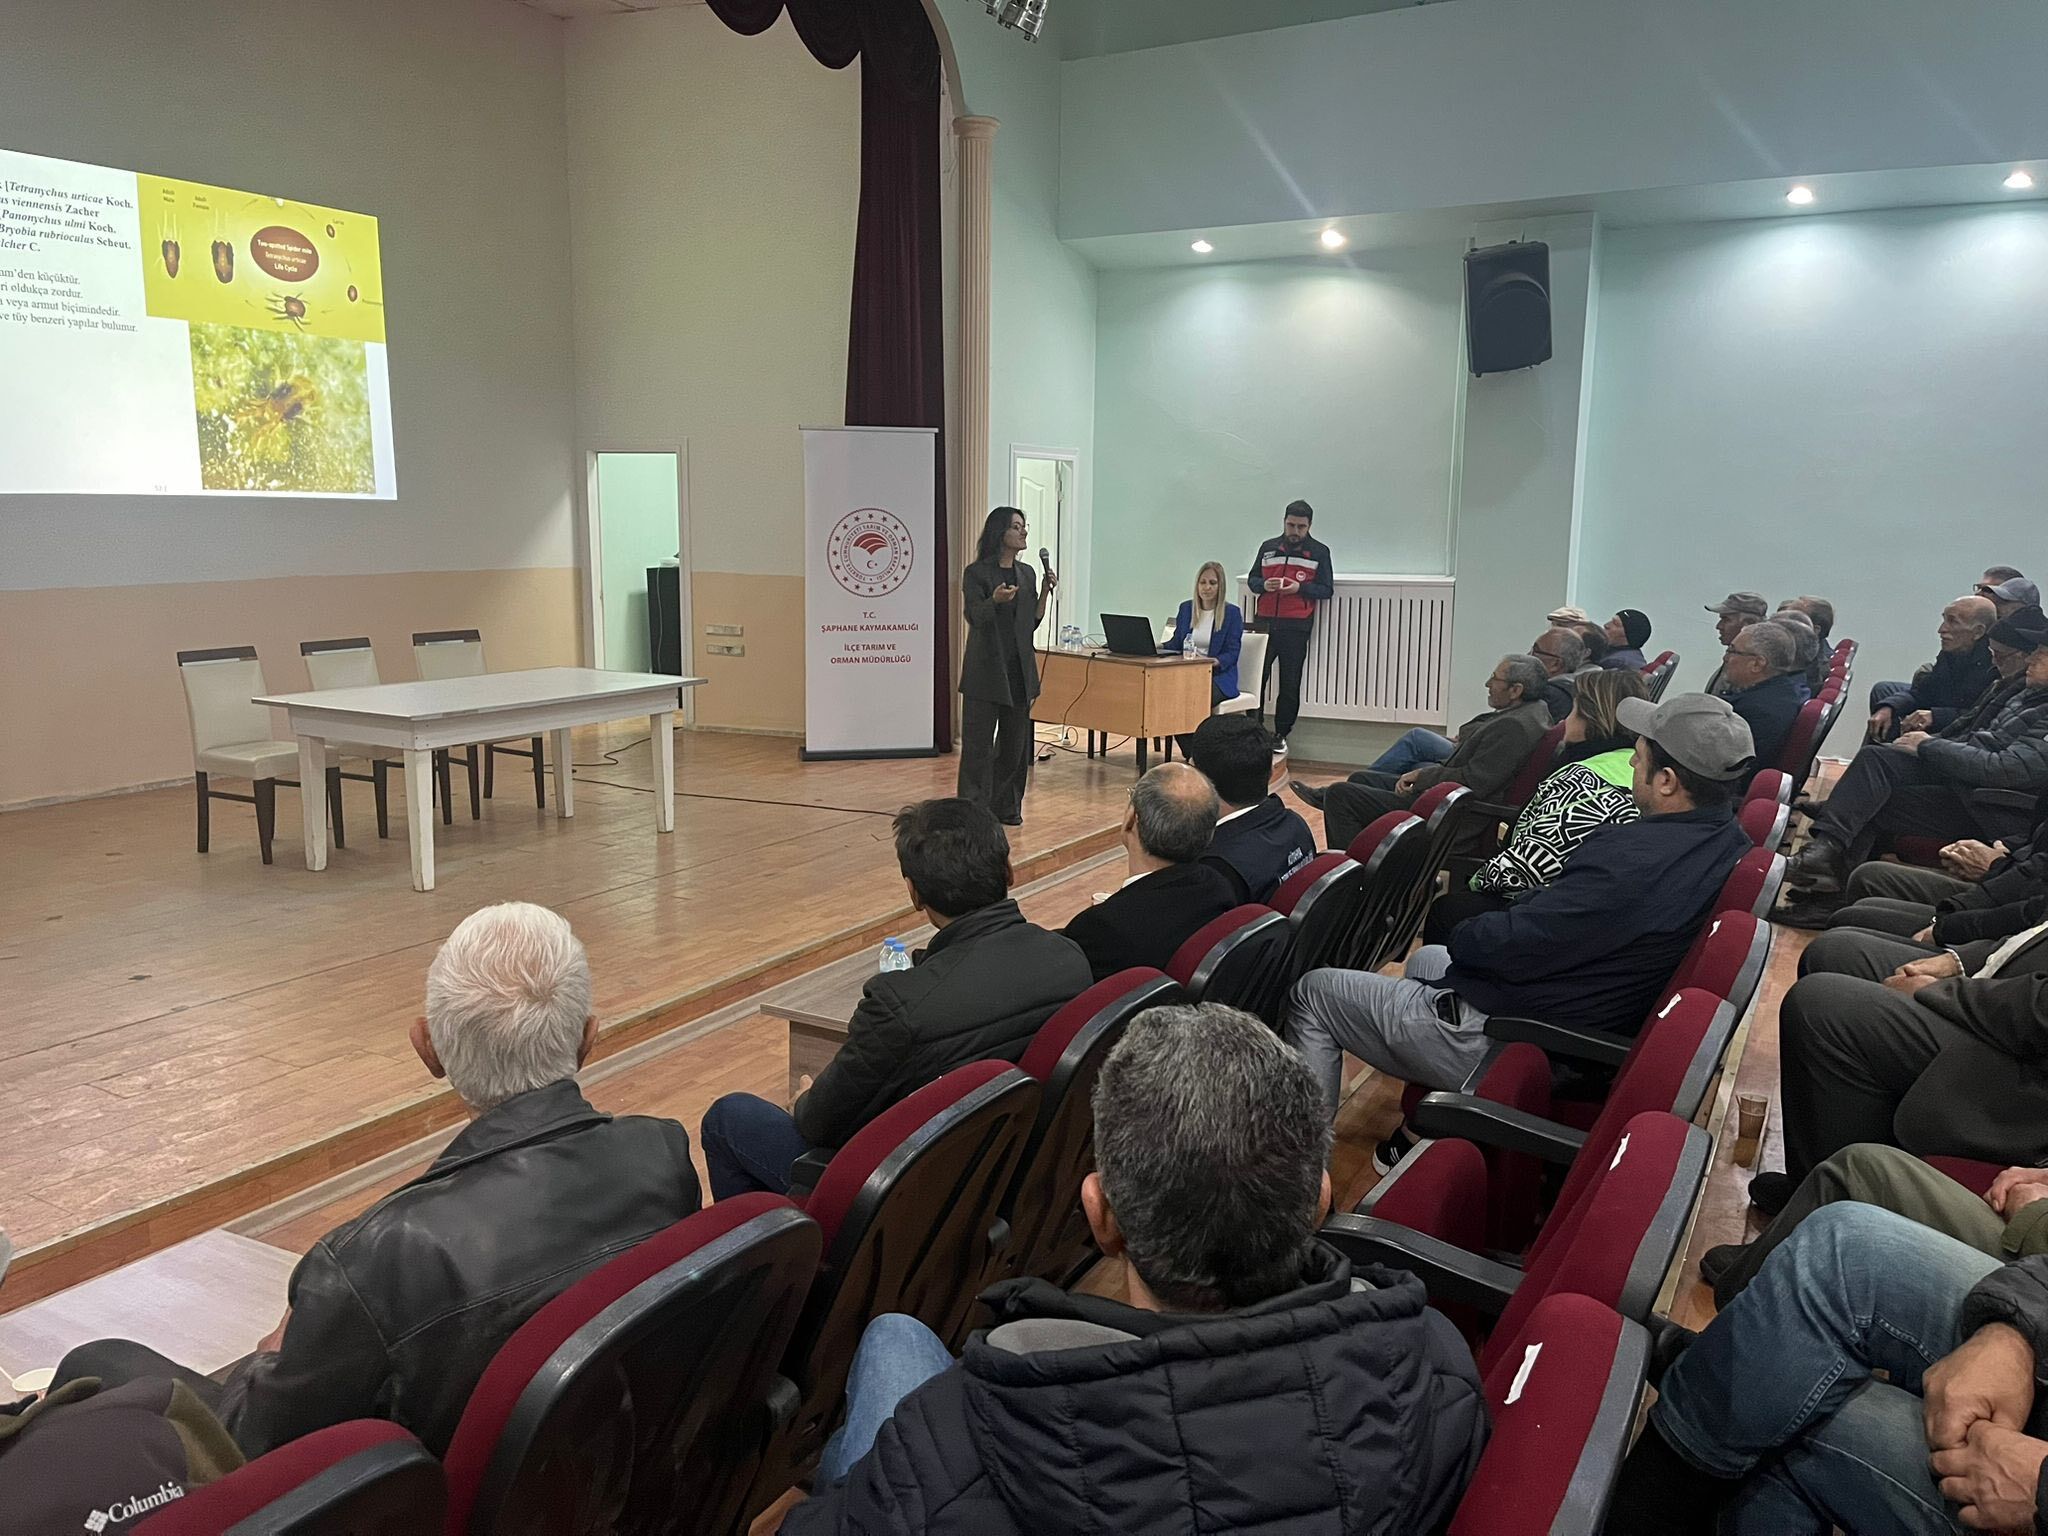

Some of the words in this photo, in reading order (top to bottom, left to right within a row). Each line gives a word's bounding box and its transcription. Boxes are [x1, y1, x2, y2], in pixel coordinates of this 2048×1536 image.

[12, 198, 63, 212] viennensis
[65, 204, 100, 217] Zacher
[71, 192, 103, 205] urticae
[106, 196, 133, 208] Koch.
[2, 209, 62, 225] Panonychus
[64, 219, 86, 229] ulmi
[88, 221, 117, 233] Koch.
[39, 230, 94, 244] rubrioculus
[29, 242, 41, 252] C.
[37, 270, 81, 285] küçüktür.
[10, 282, 49, 296] oldukça
[50, 288, 83, 299] zordur.
[31, 300, 59, 310] armut
[61, 301, 121, 317] biçimindedir.
[12, 312, 28, 324] tüy
[30, 313, 66, 326] benzeri
[67, 317, 99, 330] yapılar
[862, 611, 876, 619] T.C.
[821, 624, 858, 633] ŞAPHANE
[859, 623, 919, 632] KAYMAKAMLIĞI
[844, 643, 860, 652] İLÇE
[886, 643, 897, 651] VE
[830, 656, 860, 664] ORMAN
[861, 654, 912, 664] MÜDÜRLÜĞÜ
[108, 1481, 185, 1523] Columbia
